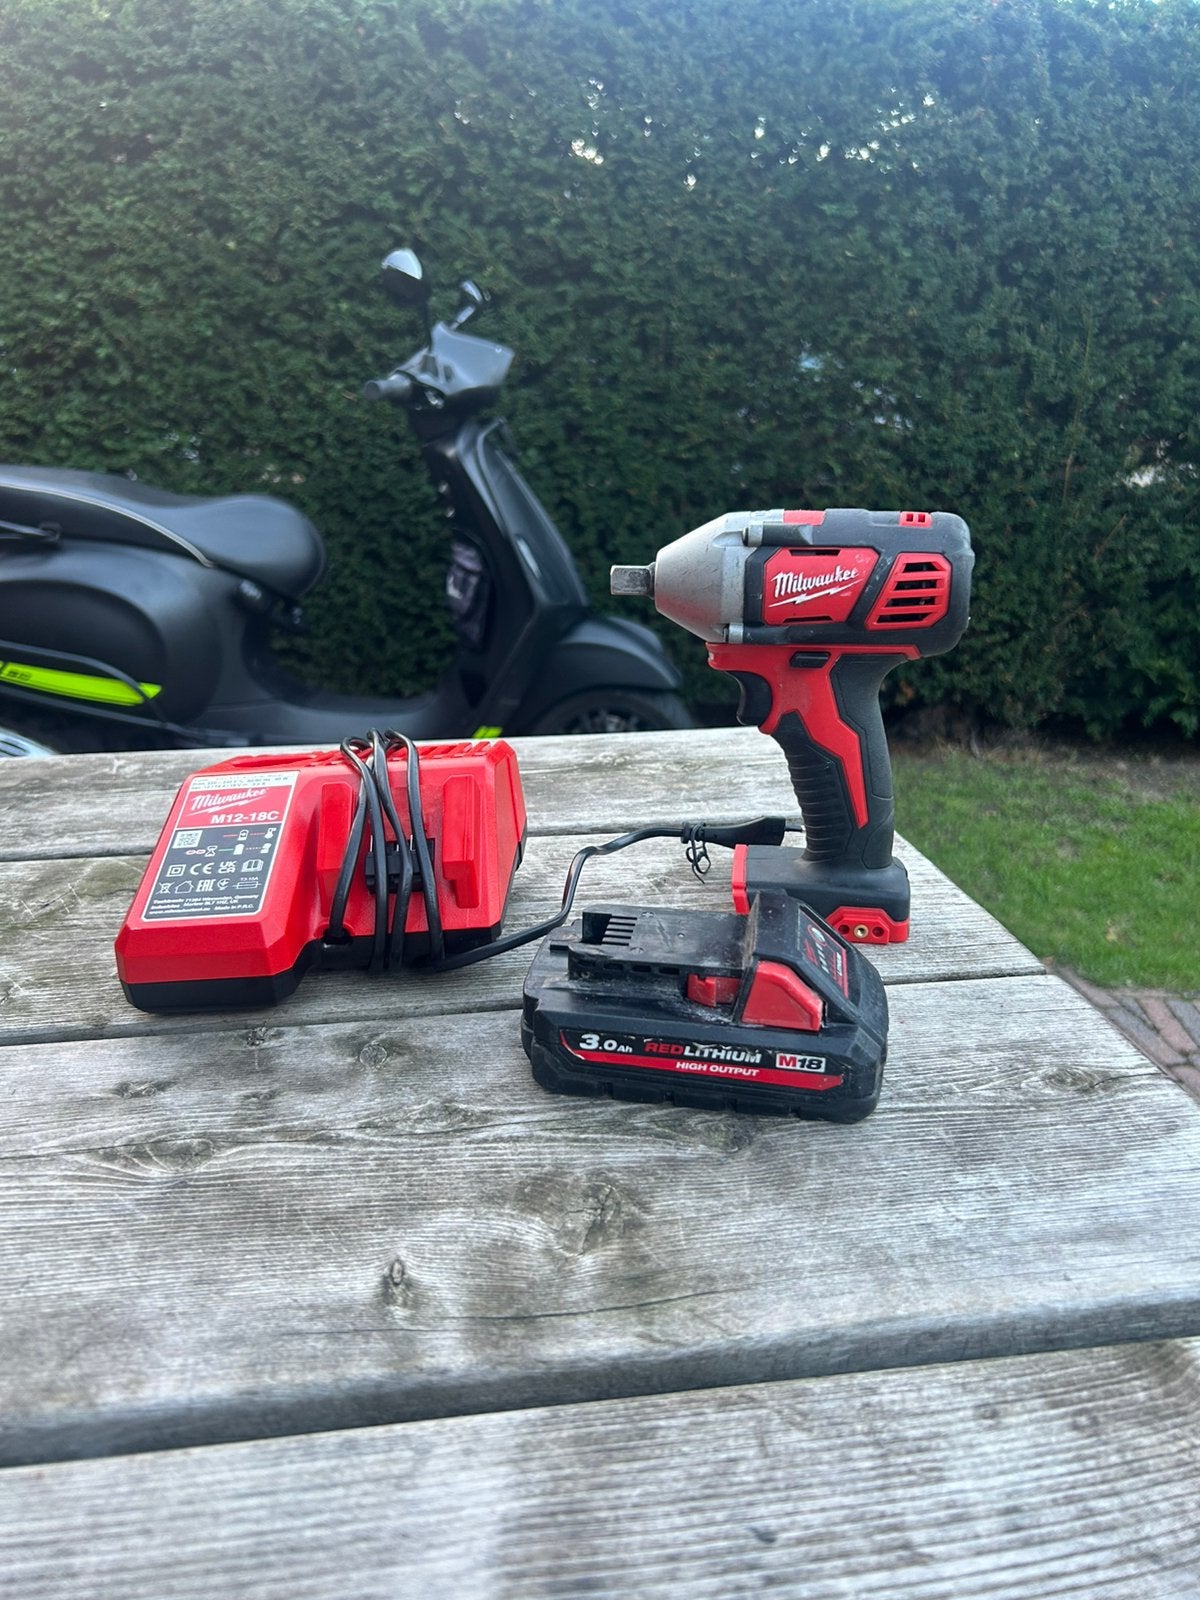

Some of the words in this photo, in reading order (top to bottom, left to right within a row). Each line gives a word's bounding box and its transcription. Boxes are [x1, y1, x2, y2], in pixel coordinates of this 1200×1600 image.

[771, 565, 859, 598] Milwaukee
[191, 788, 267, 811] Milwaukee
[210, 810, 280, 824] M12-18C
[579, 1033, 633, 1054] 3.0Ah
[644, 1041, 762, 1064] REDLITHIUM
[777, 1054, 824, 1070] M18
[675, 1061, 707, 1072] HIGH
[709, 1064, 760, 1077] OUTPUT
